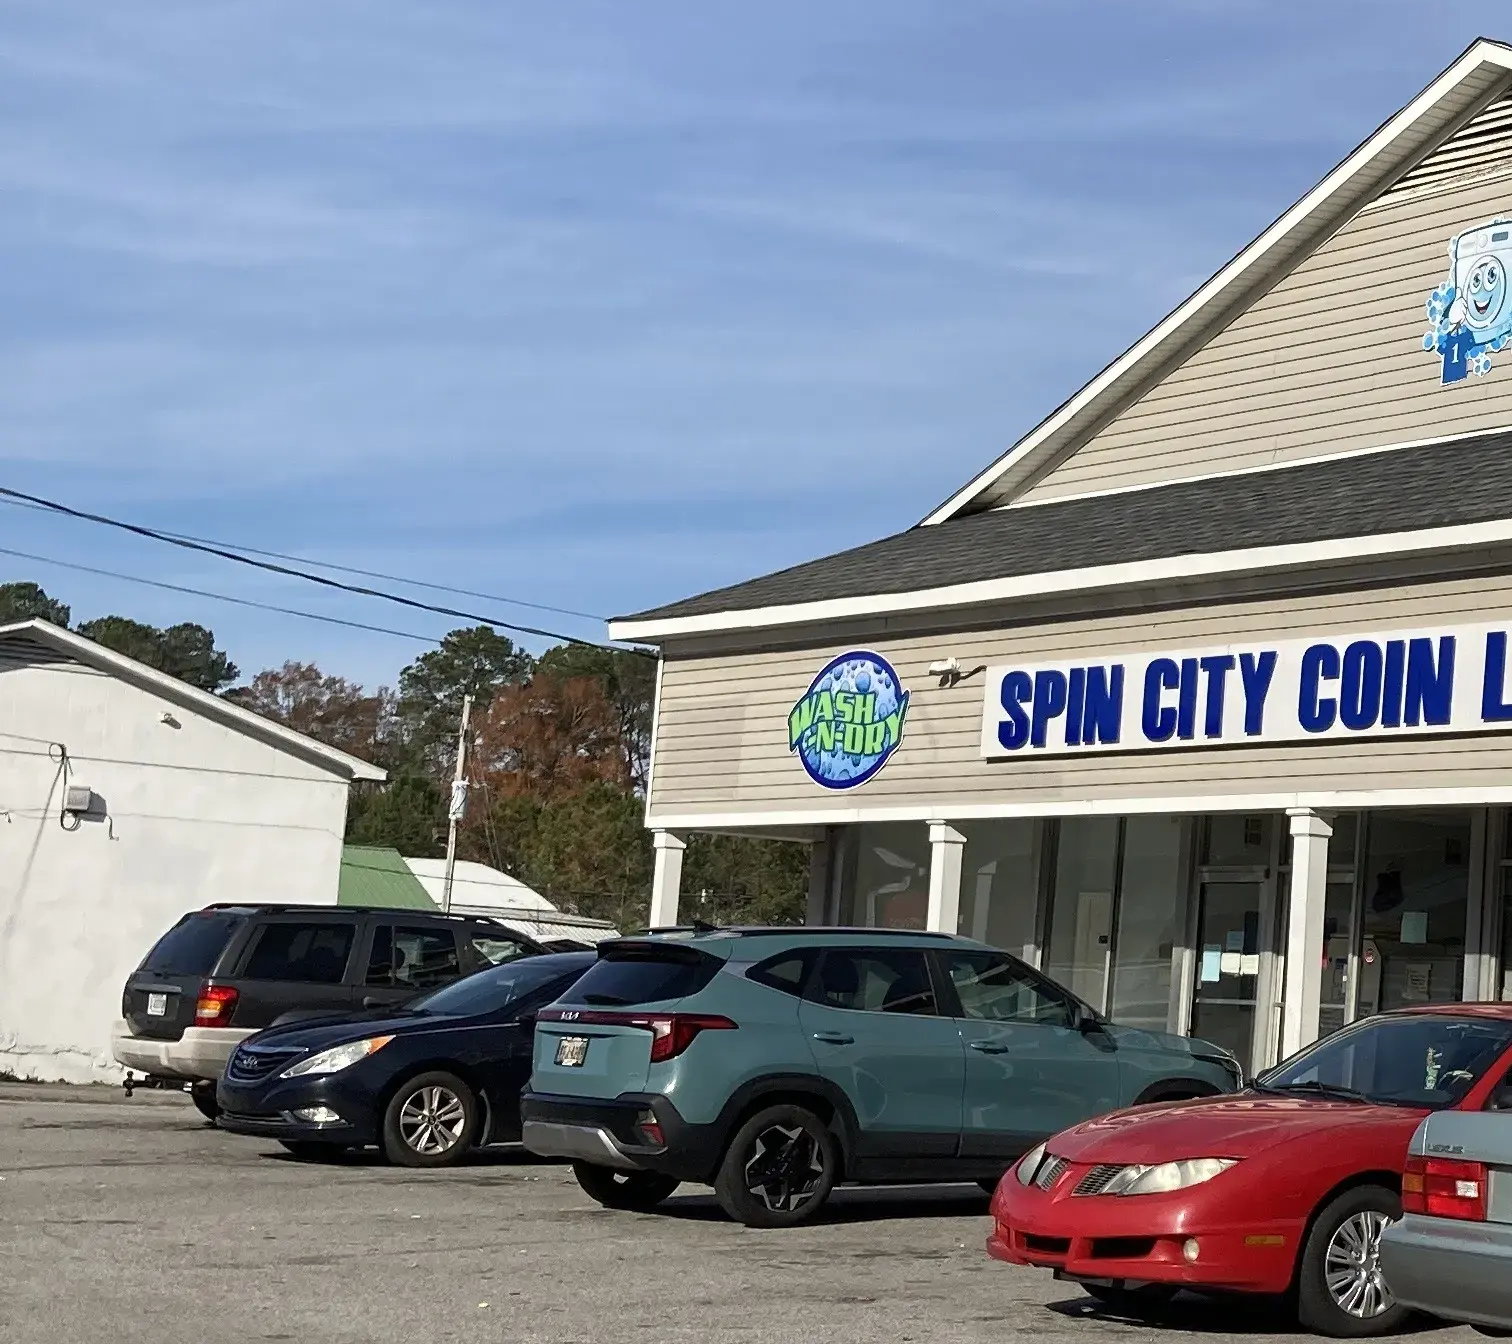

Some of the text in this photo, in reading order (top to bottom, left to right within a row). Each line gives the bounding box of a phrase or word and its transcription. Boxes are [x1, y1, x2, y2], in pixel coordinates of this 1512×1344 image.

[1451, 343, 1459, 363] 1
[790, 690, 876, 744] WASH
[998, 665, 1125, 750] SPIN
[1141, 651, 1277, 741] CITY
[1298, 635, 1456, 731] COIN
